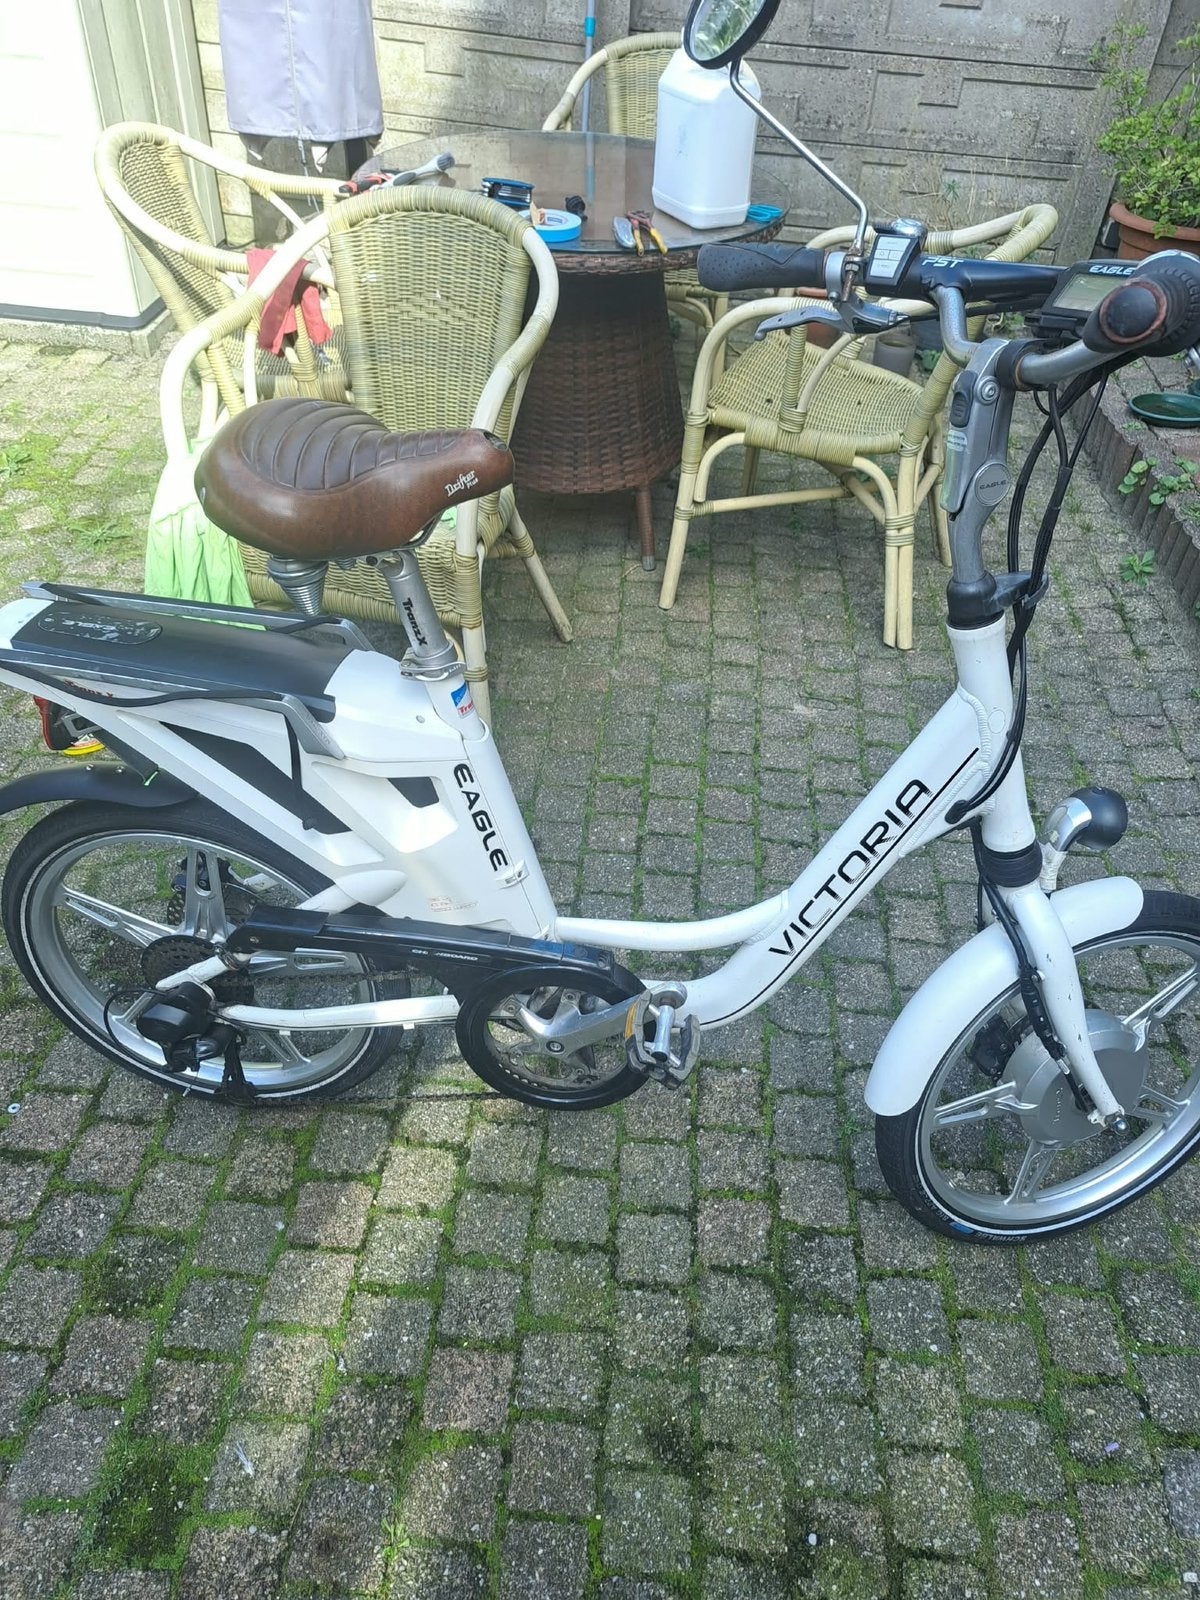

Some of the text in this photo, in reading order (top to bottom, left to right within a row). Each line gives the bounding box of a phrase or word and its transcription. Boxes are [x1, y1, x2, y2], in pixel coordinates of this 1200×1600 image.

[921, 256, 964, 269] PST
[1089, 265, 1137, 275] EAGLE
[444, 470, 475, 497] Drifter
[979, 479, 1007, 490] EAGLE
[402, 598, 427, 646] TranzX
[453, 763, 508, 872] EAGLE
[768, 779, 933, 956] VICTORIA
